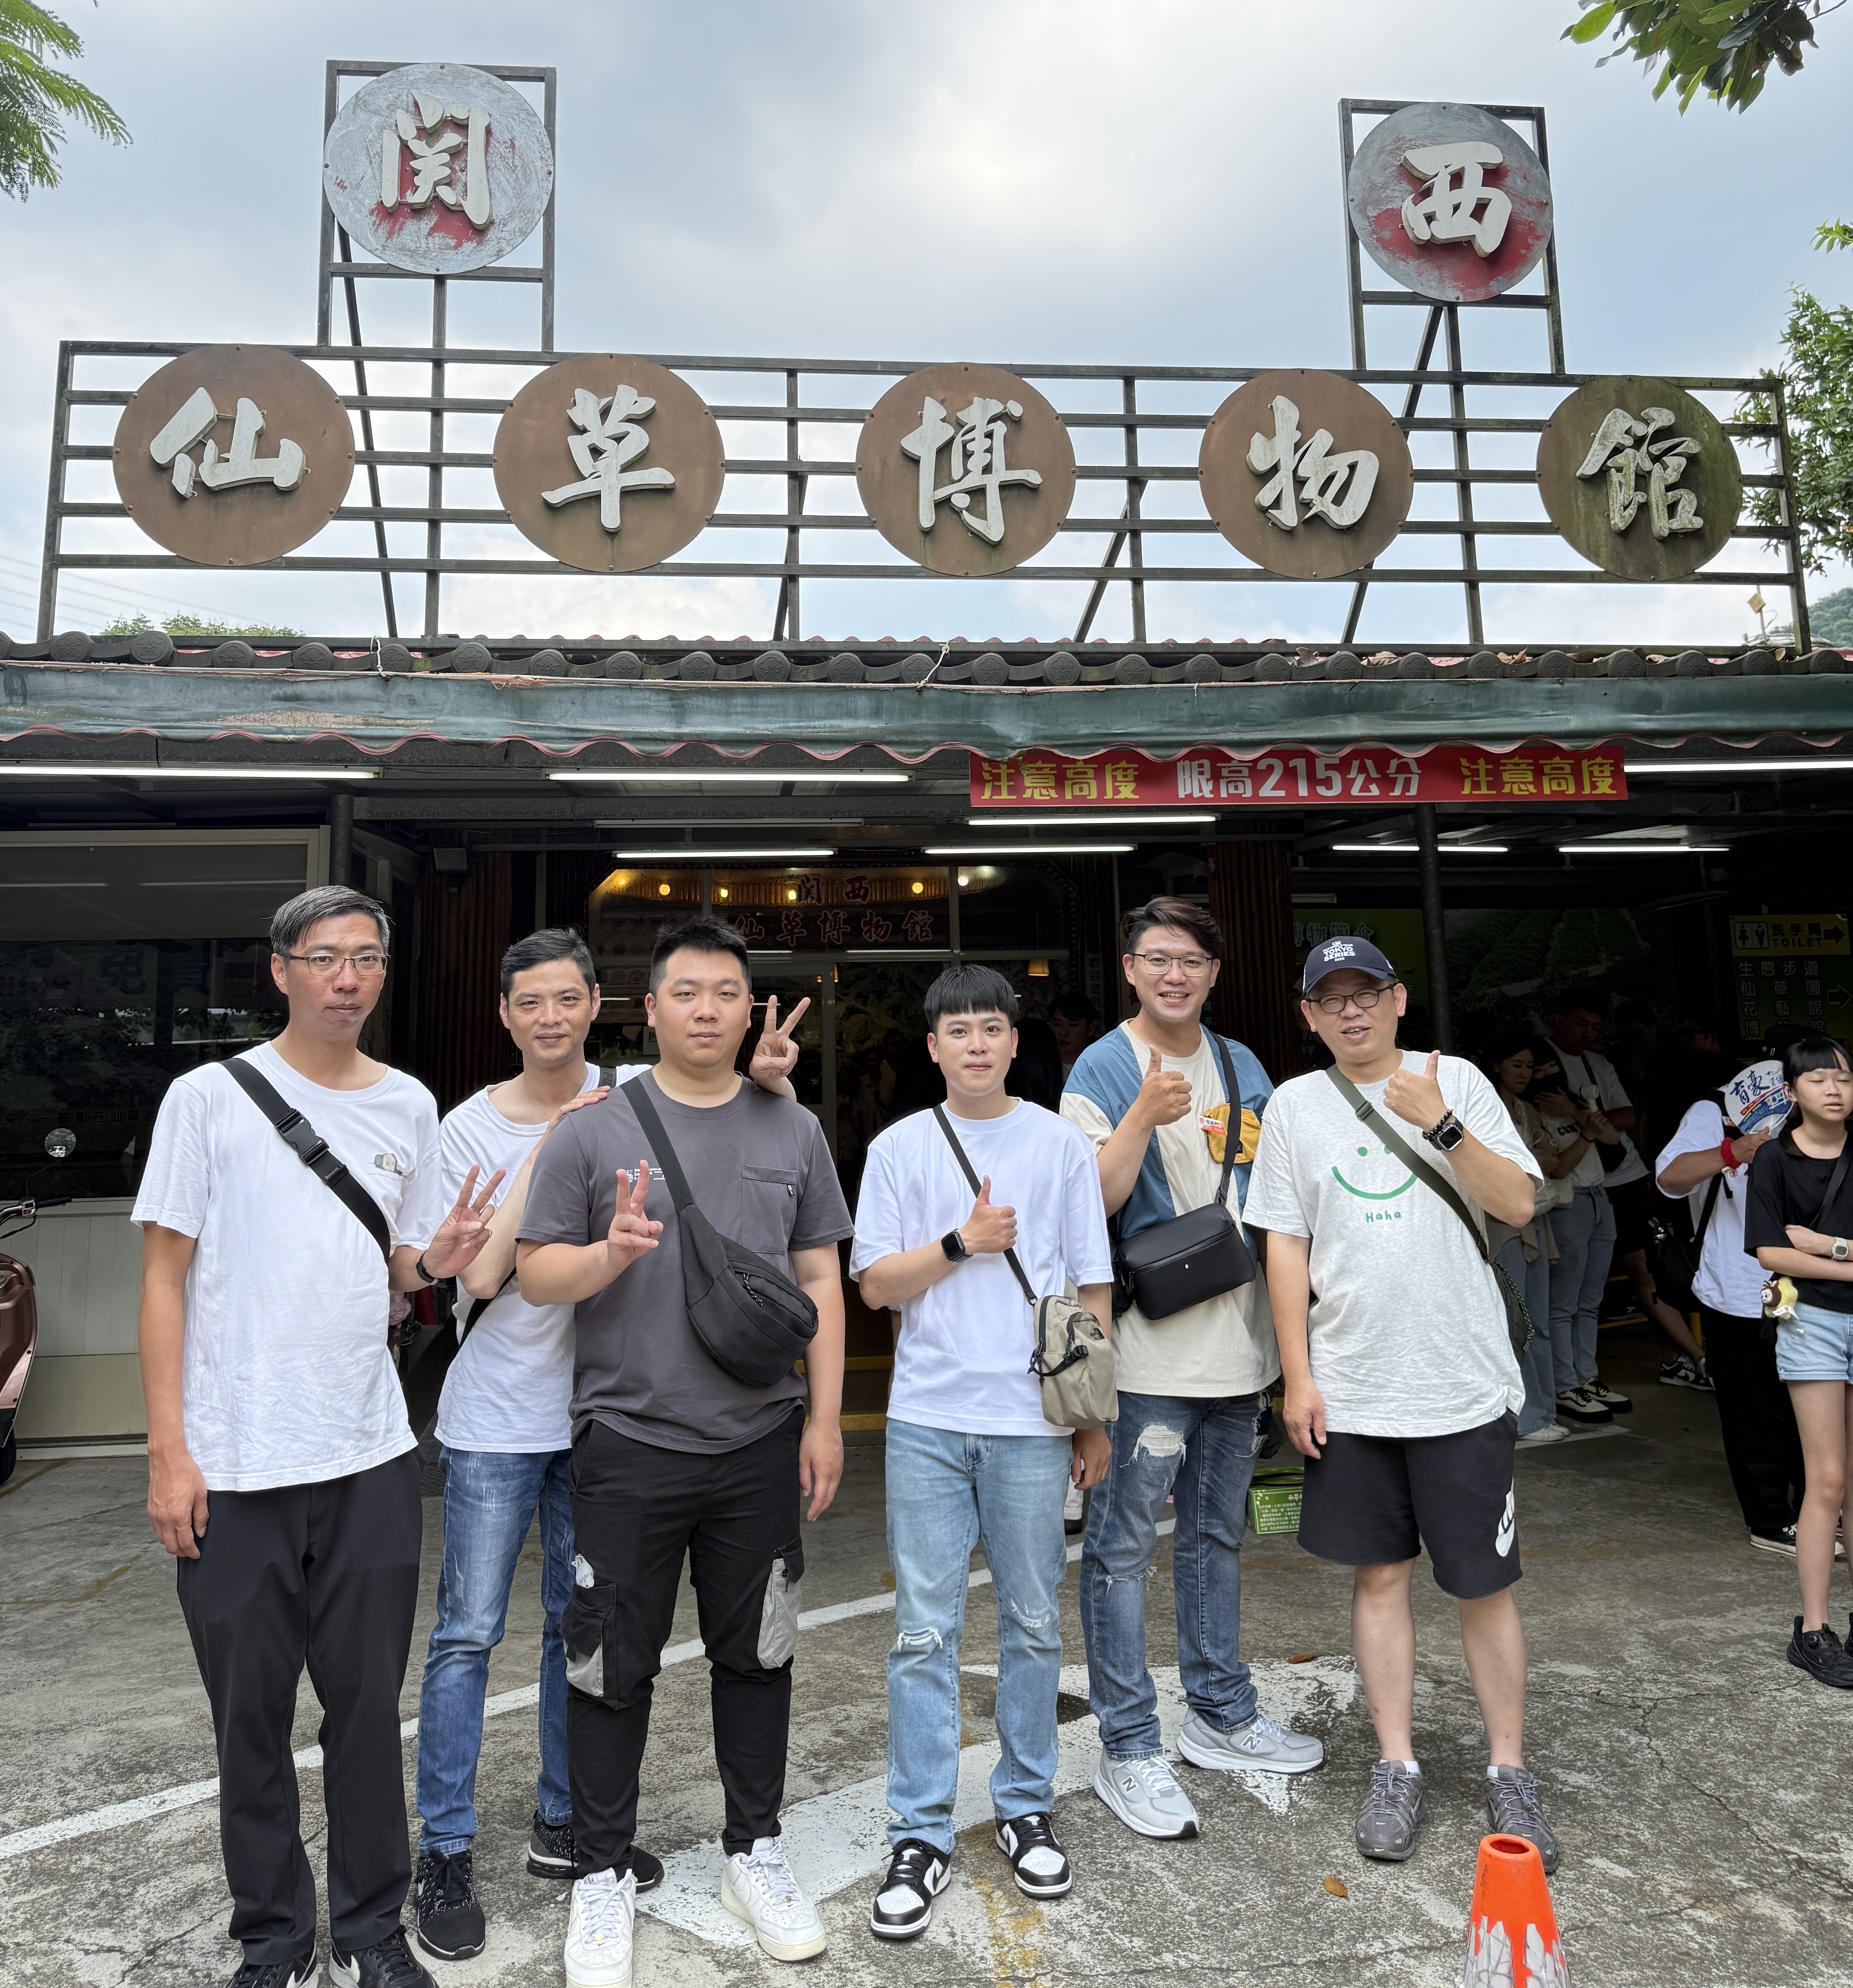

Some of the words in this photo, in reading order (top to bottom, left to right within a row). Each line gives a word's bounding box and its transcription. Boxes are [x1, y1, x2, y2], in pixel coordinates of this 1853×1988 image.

[1401, 141, 1512, 258] 西
[149, 383, 1705, 545] 仙草博物館
[981, 760, 1140, 800] 注意高度
[1177, 758, 1422, 798] 限高215公分
[1459, 756, 1617, 795] 注意高度
[736, 910, 933, 946] 仙草博物館
[1772, 922, 1821, 936] 洗手間
[1323, 947, 1353, 956] TOKYO
[1772, 938, 1823, 948] TOILET
[1324, 951, 1356, 961] SERIES
[1744, 1019, 1825, 1039] 博館
[1366, 1210, 1401, 1223] Haha
[1121, 1775, 1139, 1794] N
